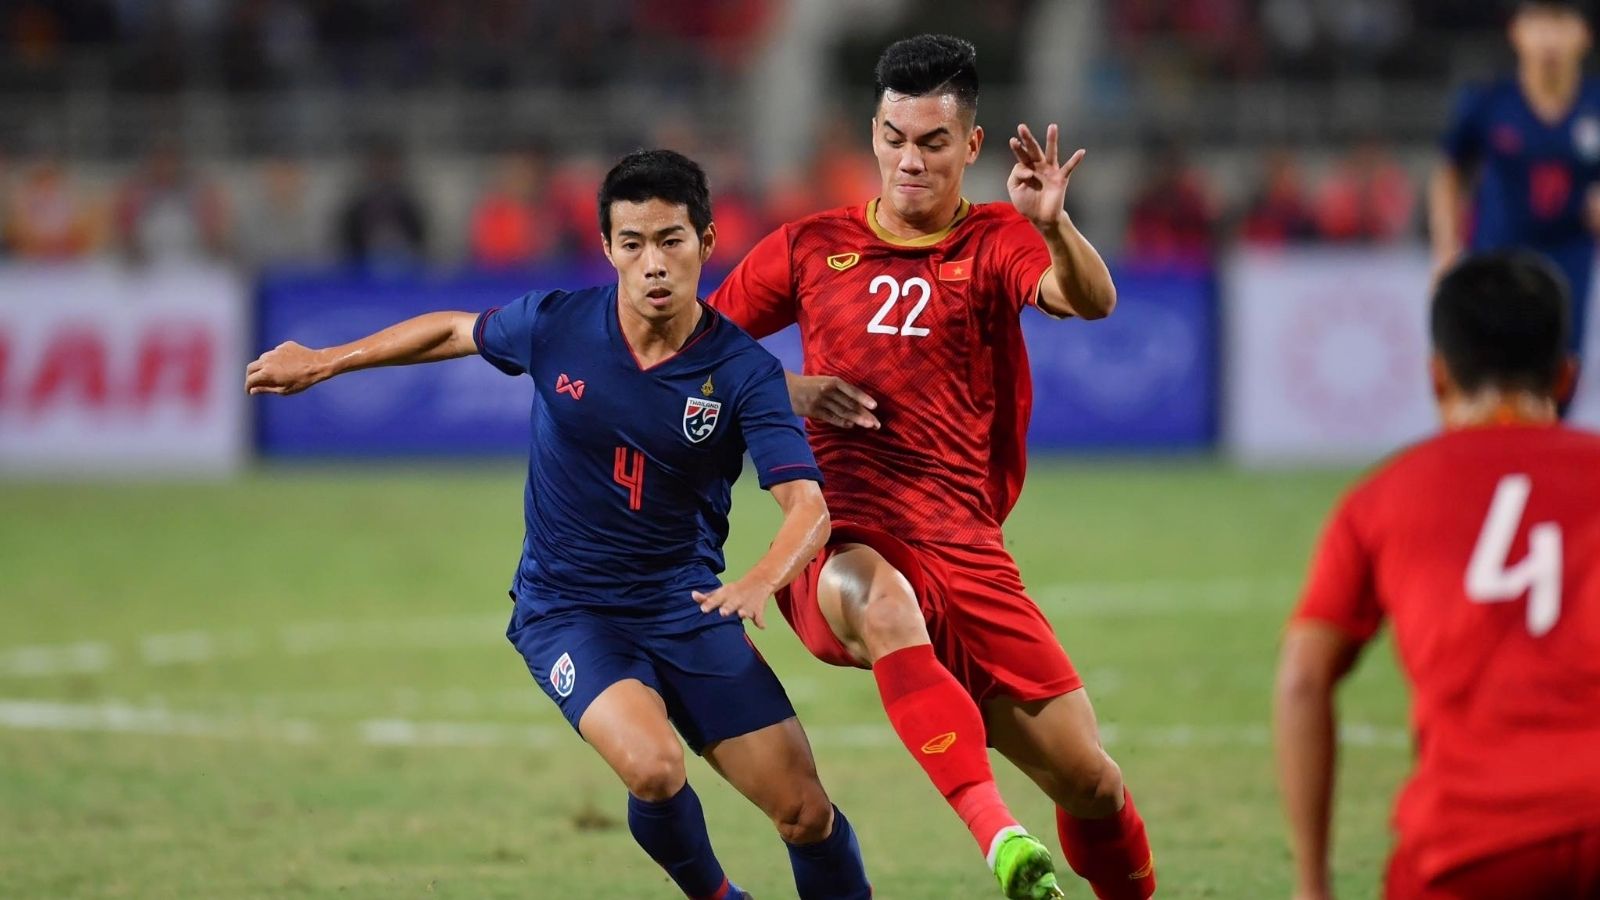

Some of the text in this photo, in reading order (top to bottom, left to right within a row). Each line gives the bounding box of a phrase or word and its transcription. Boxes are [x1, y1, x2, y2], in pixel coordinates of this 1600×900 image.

[866, 274, 931, 337] 22
[613, 447, 645, 511] 4
[1465, 474, 1562, 637] 4
